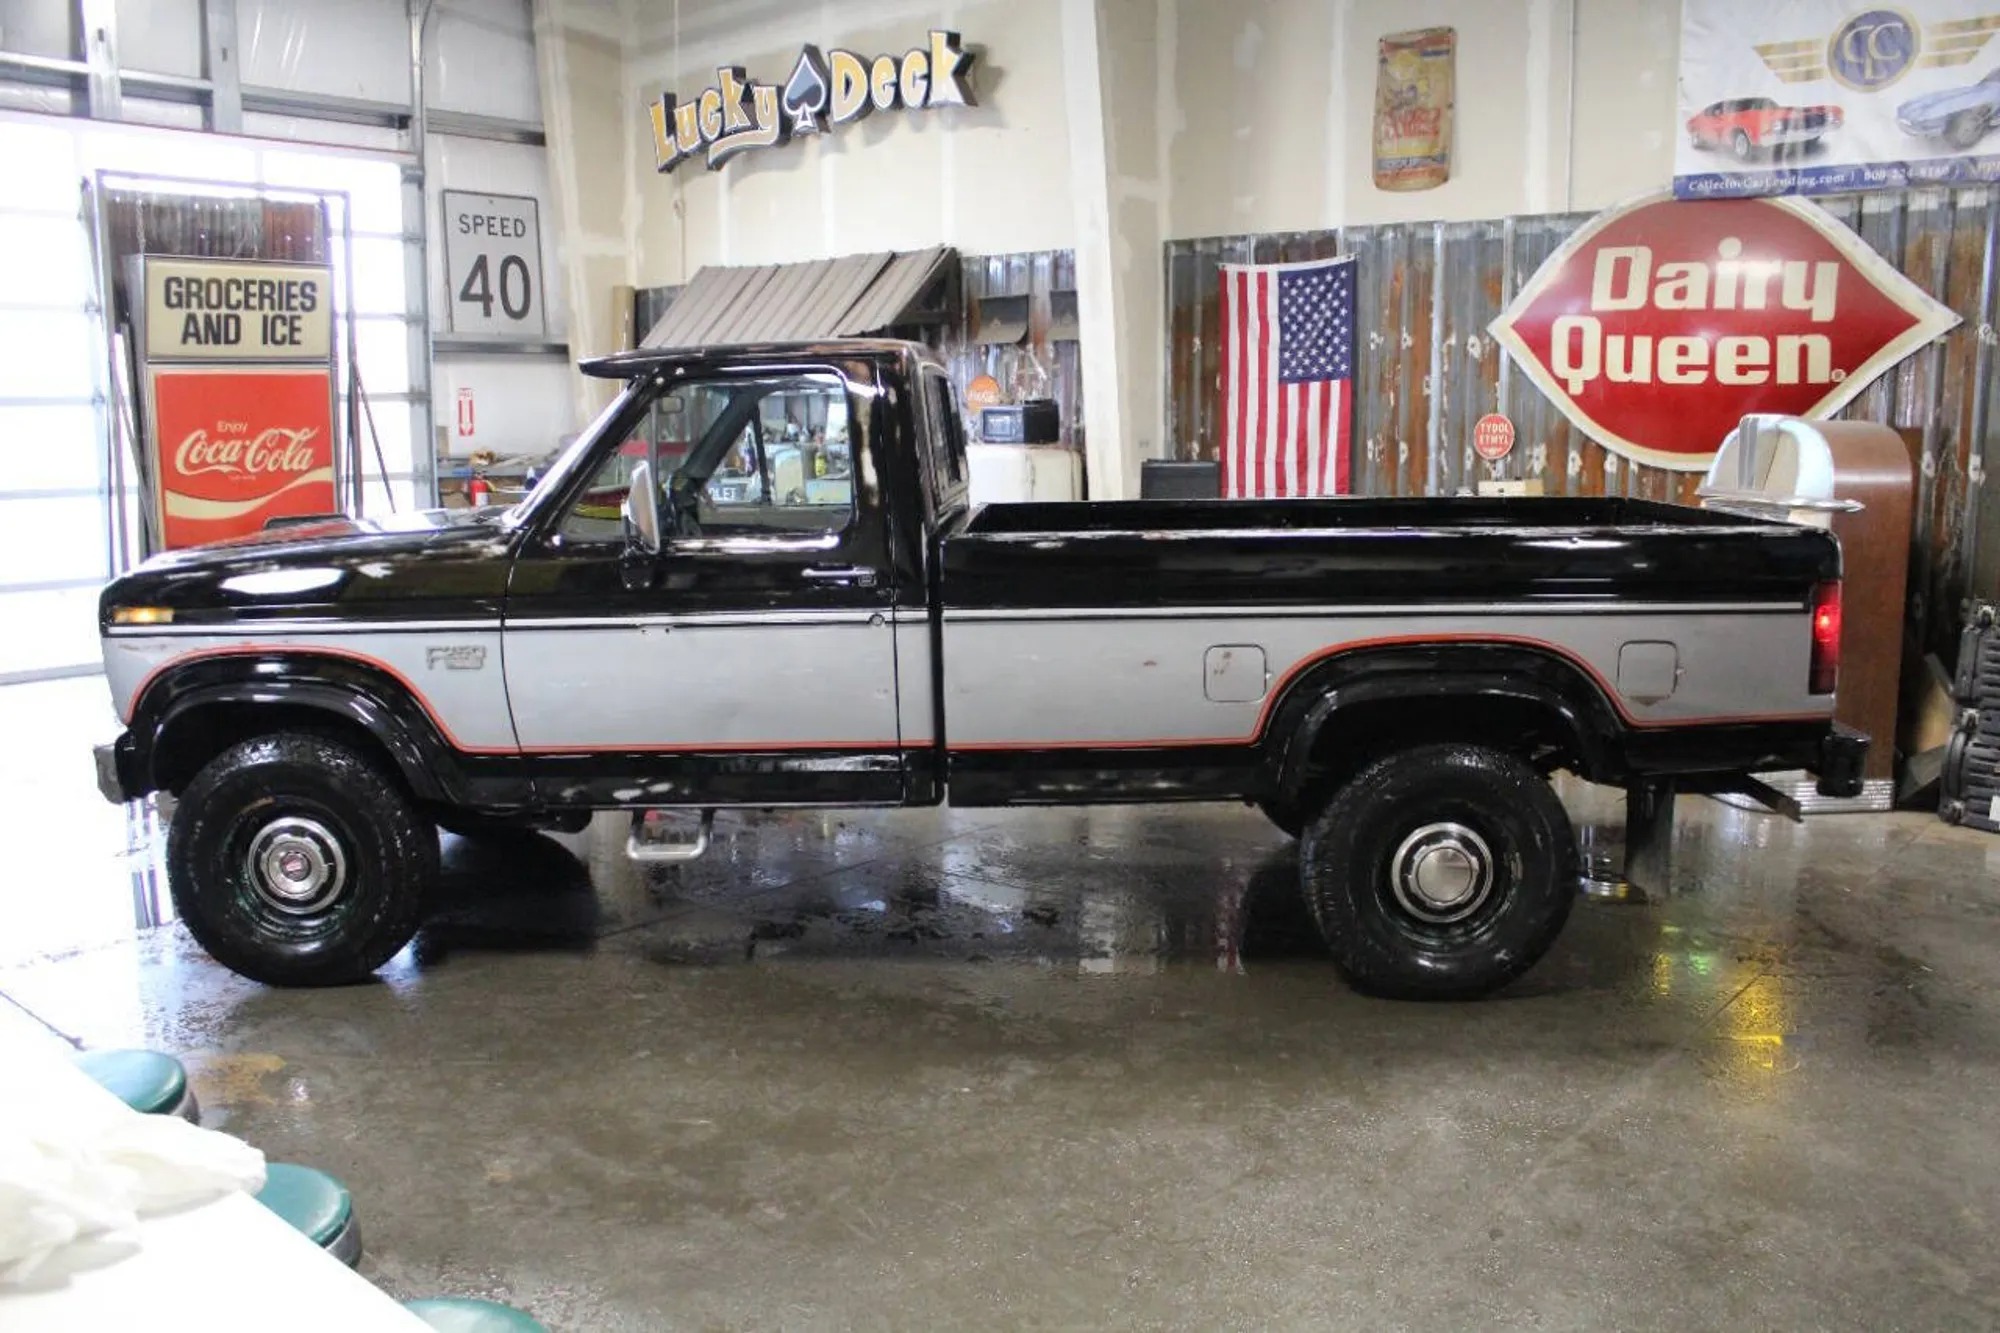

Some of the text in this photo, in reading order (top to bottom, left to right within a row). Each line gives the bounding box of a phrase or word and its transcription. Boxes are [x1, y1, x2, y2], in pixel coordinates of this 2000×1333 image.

[650, 30, 977, 173] Lucky Deck
[459, 213, 526, 239] SPEED
[164, 276, 318, 313] GROCERIES
[459, 254, 531, 320] 40
[1590, 237, 1839, 322] Dairy
[181, 313, 302, 345] AND ICE
[1551, 315, 1831, 396] Queen
[216, 420, 248, 435] Enjoy
[1480, 423, 1509, 433] TYDOL
[175, 428, 320, 476] Coca-Cola
